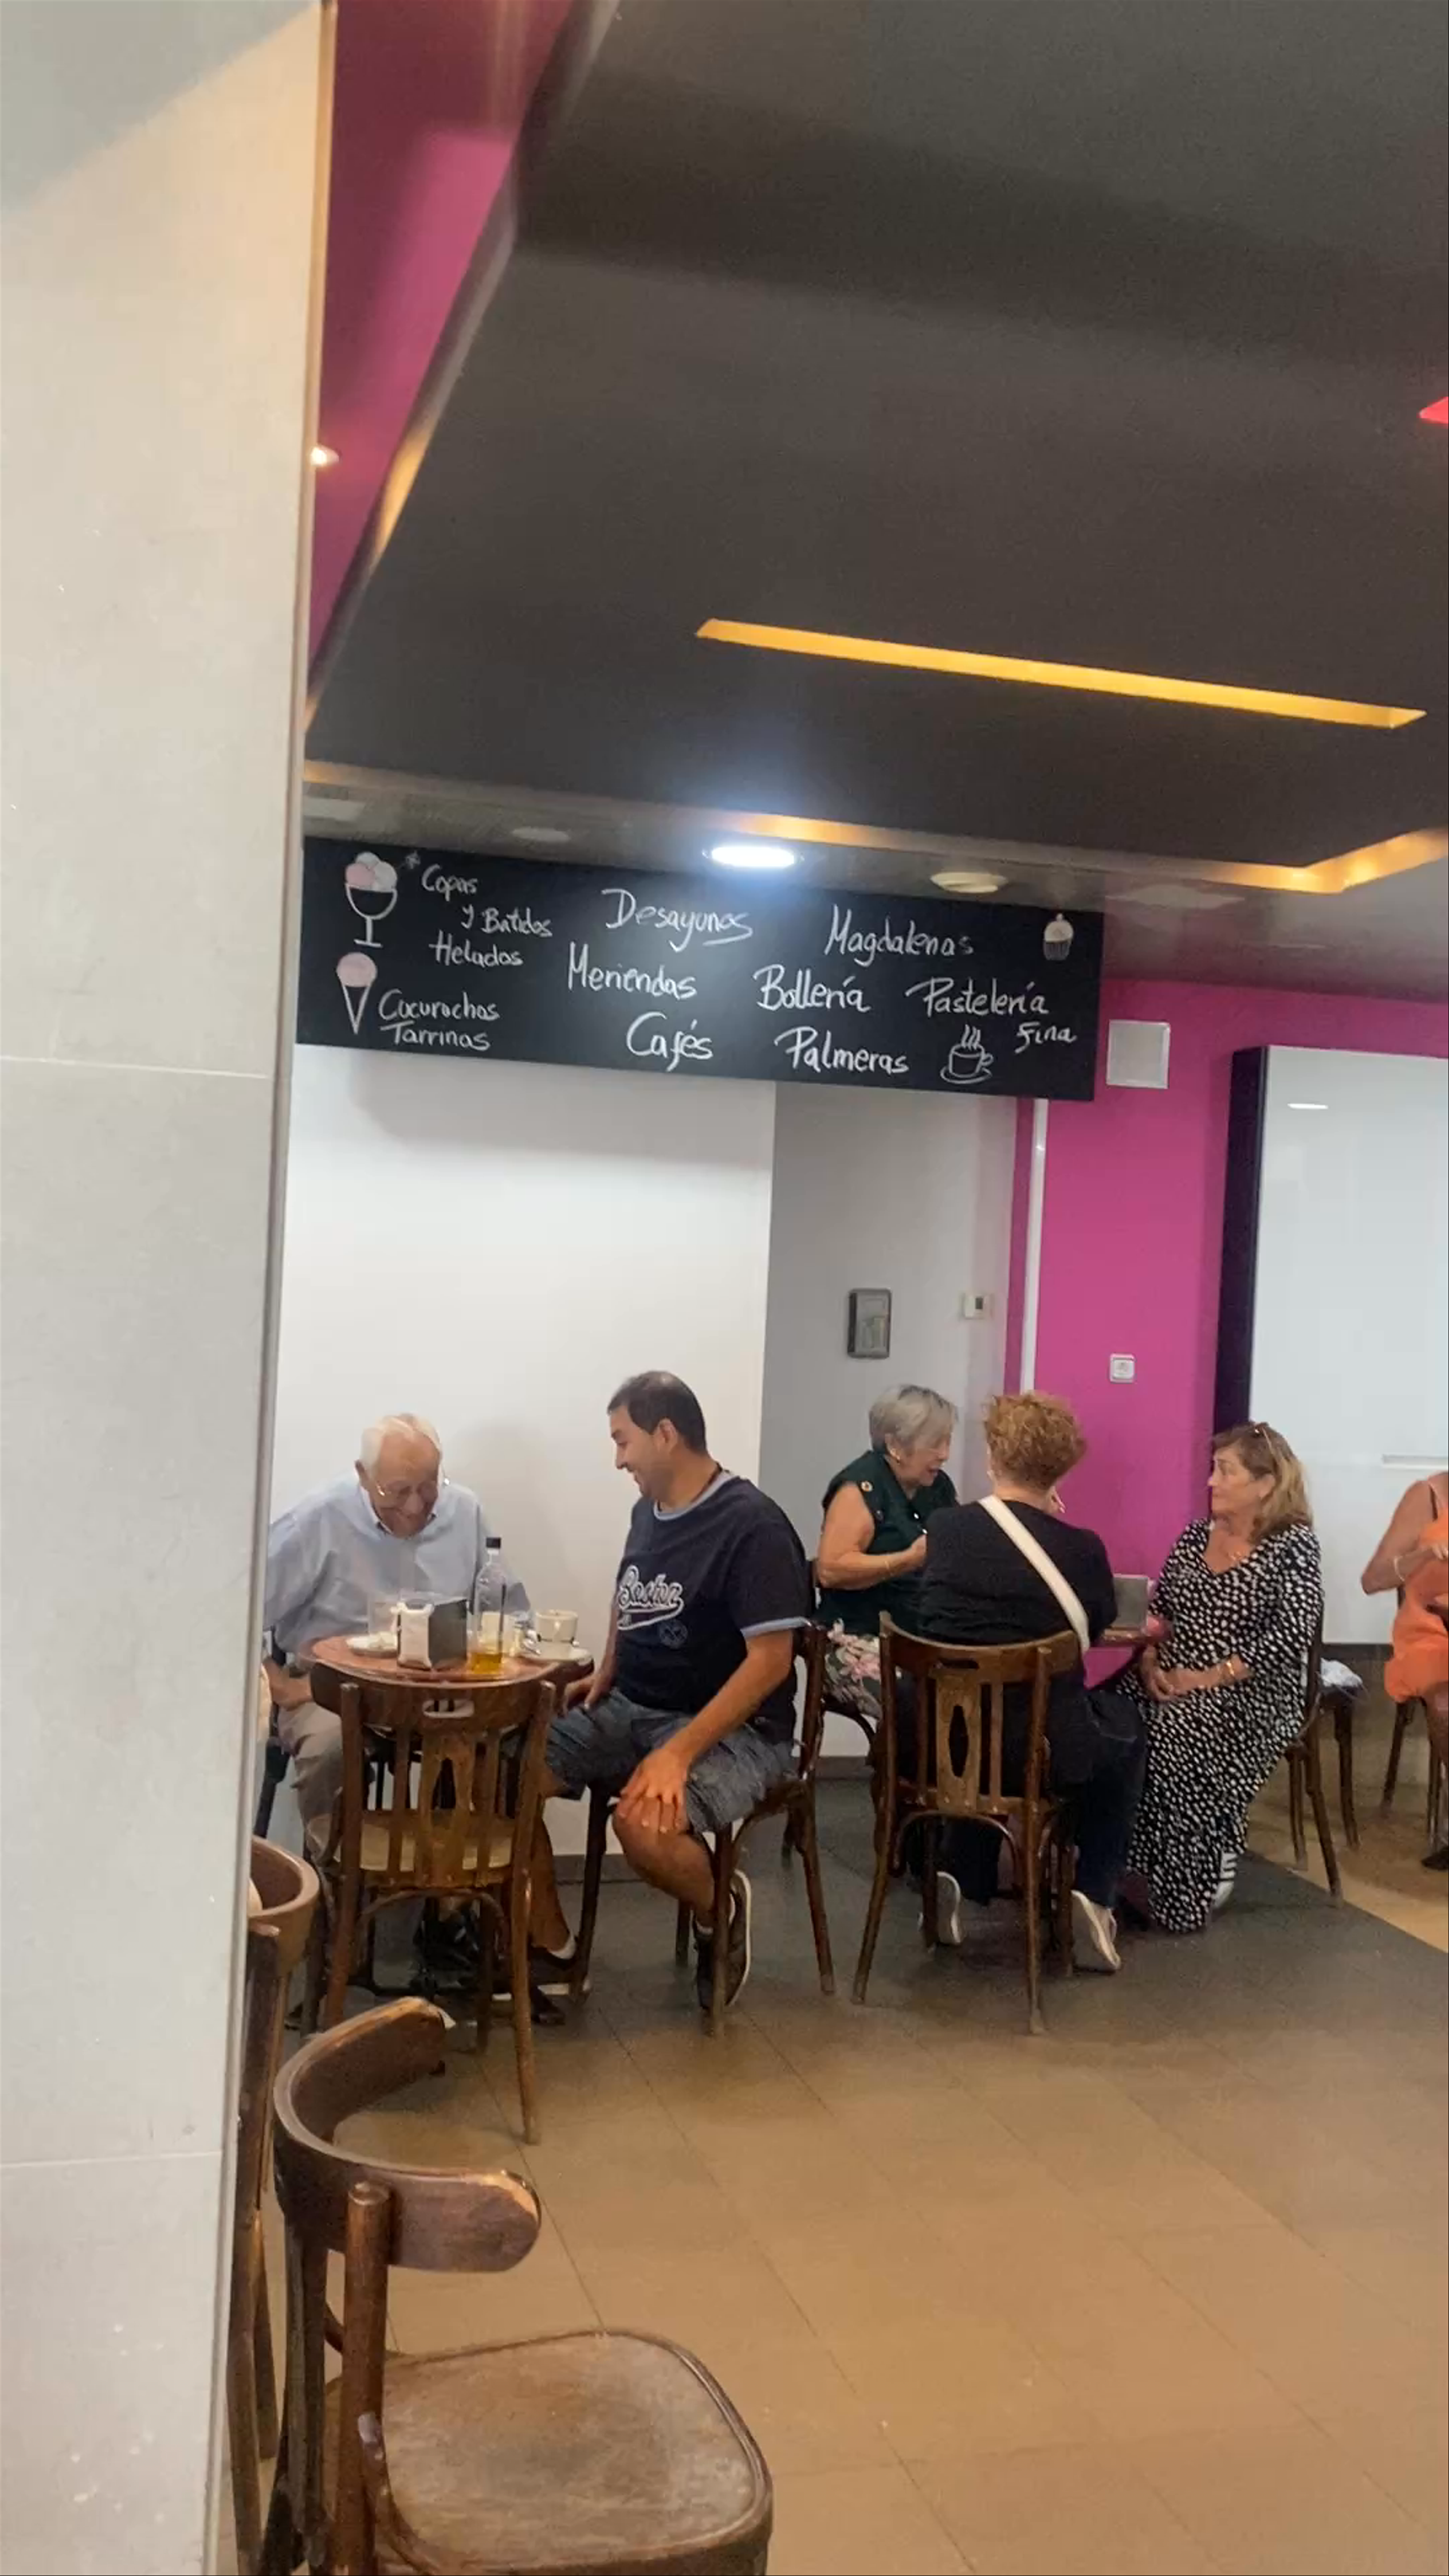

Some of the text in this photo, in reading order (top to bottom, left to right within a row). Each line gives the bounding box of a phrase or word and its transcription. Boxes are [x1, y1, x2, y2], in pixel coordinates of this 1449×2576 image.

[421, 863, 478, 901] Copas
[481, 907, 553, 937] Batidos
[601, 888, 753, 953] Desayunos
[824, 904, 974, 967] Magdalenas
[429, 929, 524, 968] Helados
[568, 941, 697, 1000] Meriendas
[754, 964, 871, 1012] Bollería
[905, 976, 1049, 1017] Pastelería
[380, 1020, 491, 1051] Tarrinas
[626, 1011, 714, 1072] Cafés
[775, 1026, 909, 1074] Palmeras
